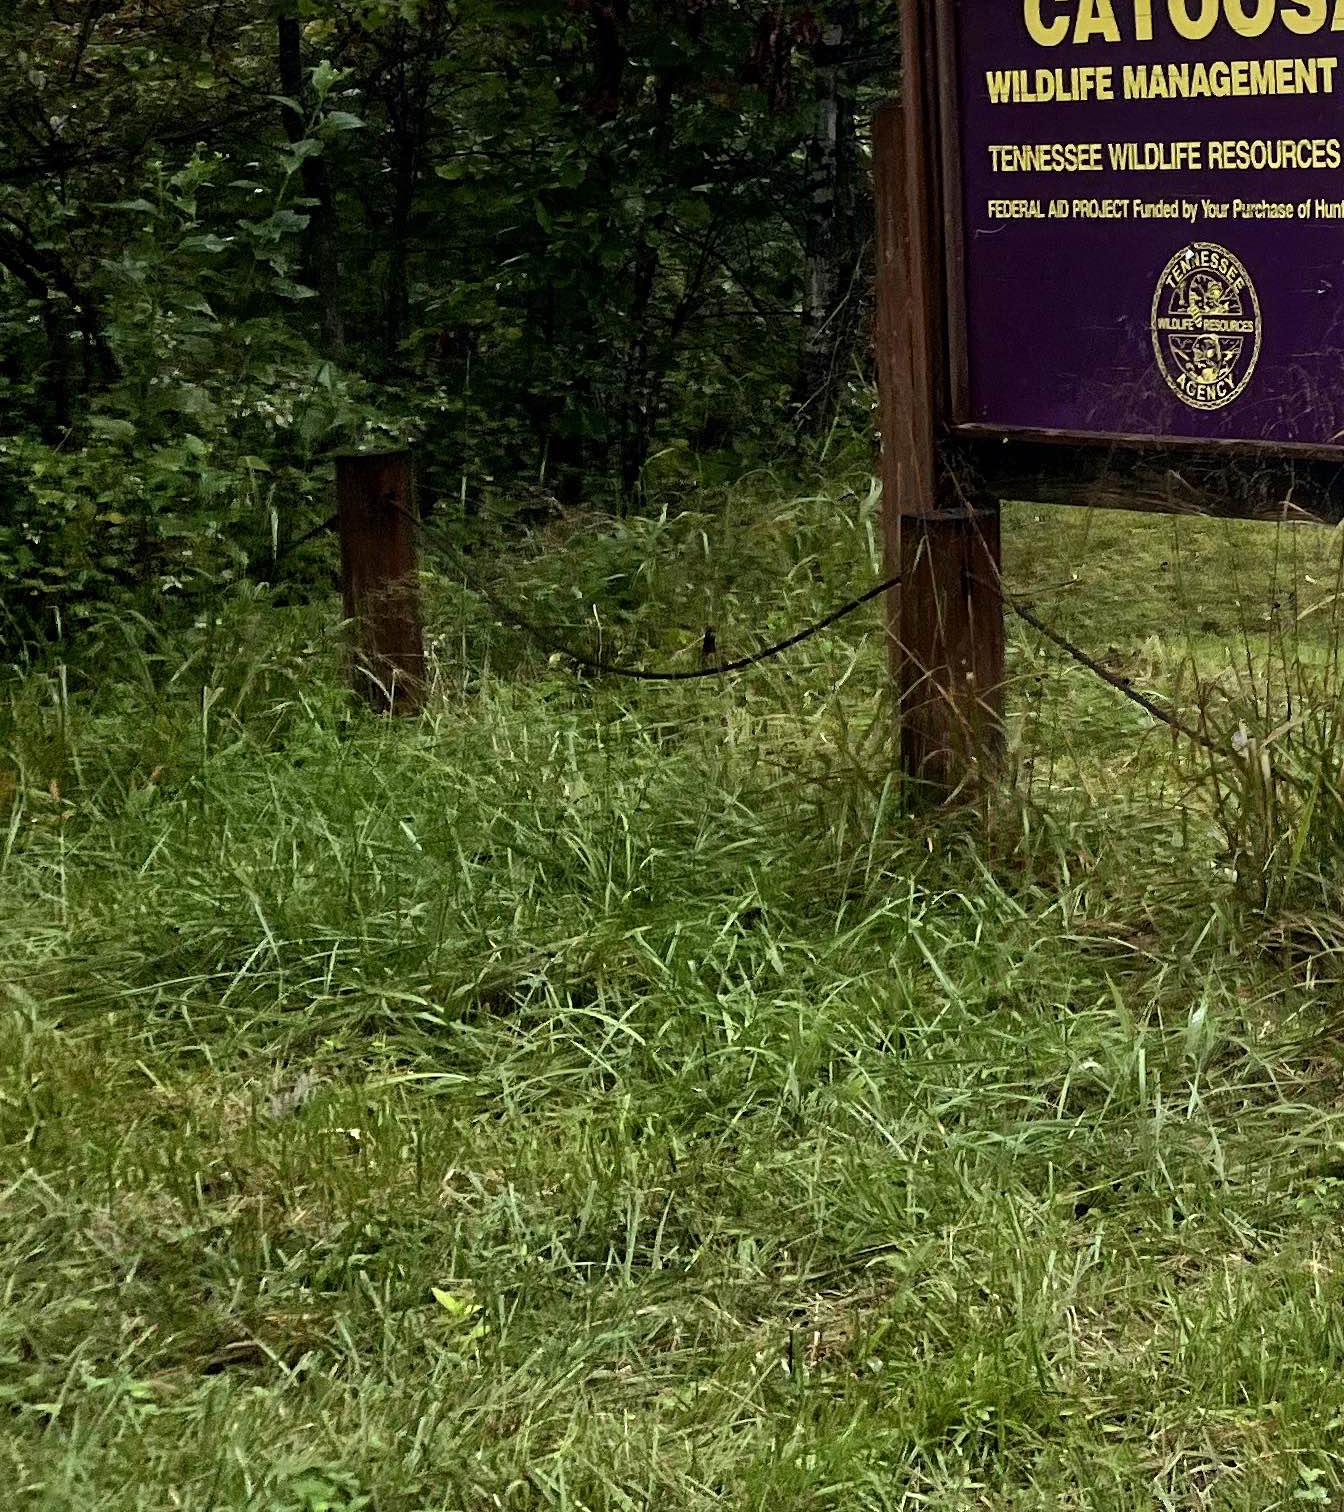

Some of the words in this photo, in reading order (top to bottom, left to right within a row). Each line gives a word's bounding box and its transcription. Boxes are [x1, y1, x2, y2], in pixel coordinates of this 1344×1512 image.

[986, 66, 1114, 104] WILDLIFE
[1123, 58, 1338, 99] MANAGEMENT
[988, 143, 1103, 172] TENNESSEE
[1108, 142, 1202, 171] WILDLIFE
[1208, 139, 1341, 170] RESOURCES
[988, 200, 1045, 218] FEDERAL
[1048, 200, 1069, 218] AID
[1072, 200, 1129, 218] PROJECT
[1133, 200, 1179, 218] Funded
[1181, 200, 1198, 222] by
[1201, 200, 1229, 218] Your
[1233, 200, 1294, 218] Purchase
[1297, 200, 1311, 218] of
[1166, 250, 1246, 293] TENNESSEE
[1176, 373, 1235, 401] AGENCY
